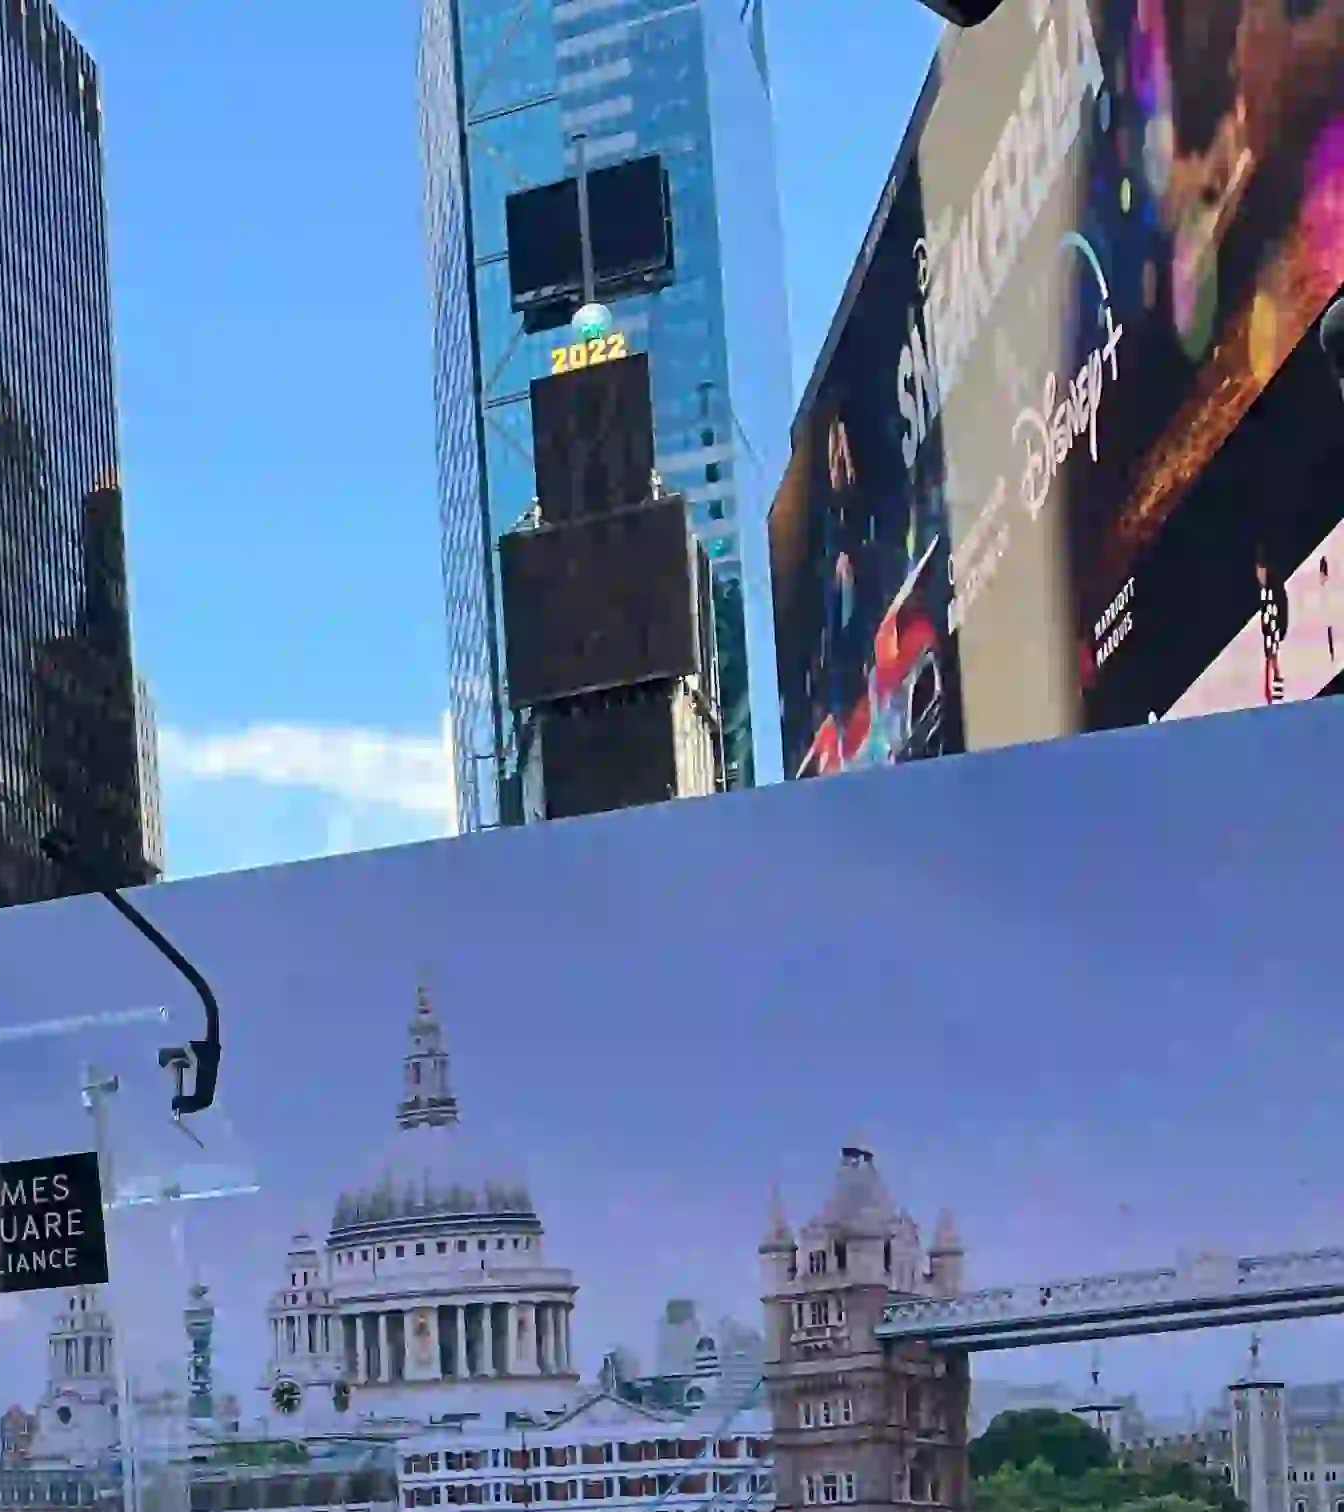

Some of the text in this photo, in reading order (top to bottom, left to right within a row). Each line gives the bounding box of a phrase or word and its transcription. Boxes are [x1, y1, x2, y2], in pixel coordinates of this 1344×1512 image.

[551, 332, 627, 374] 2022
[1094, 576, 1135, 641] MARRIOTT
[1096, 611, 1132, 668] MARQUIS
